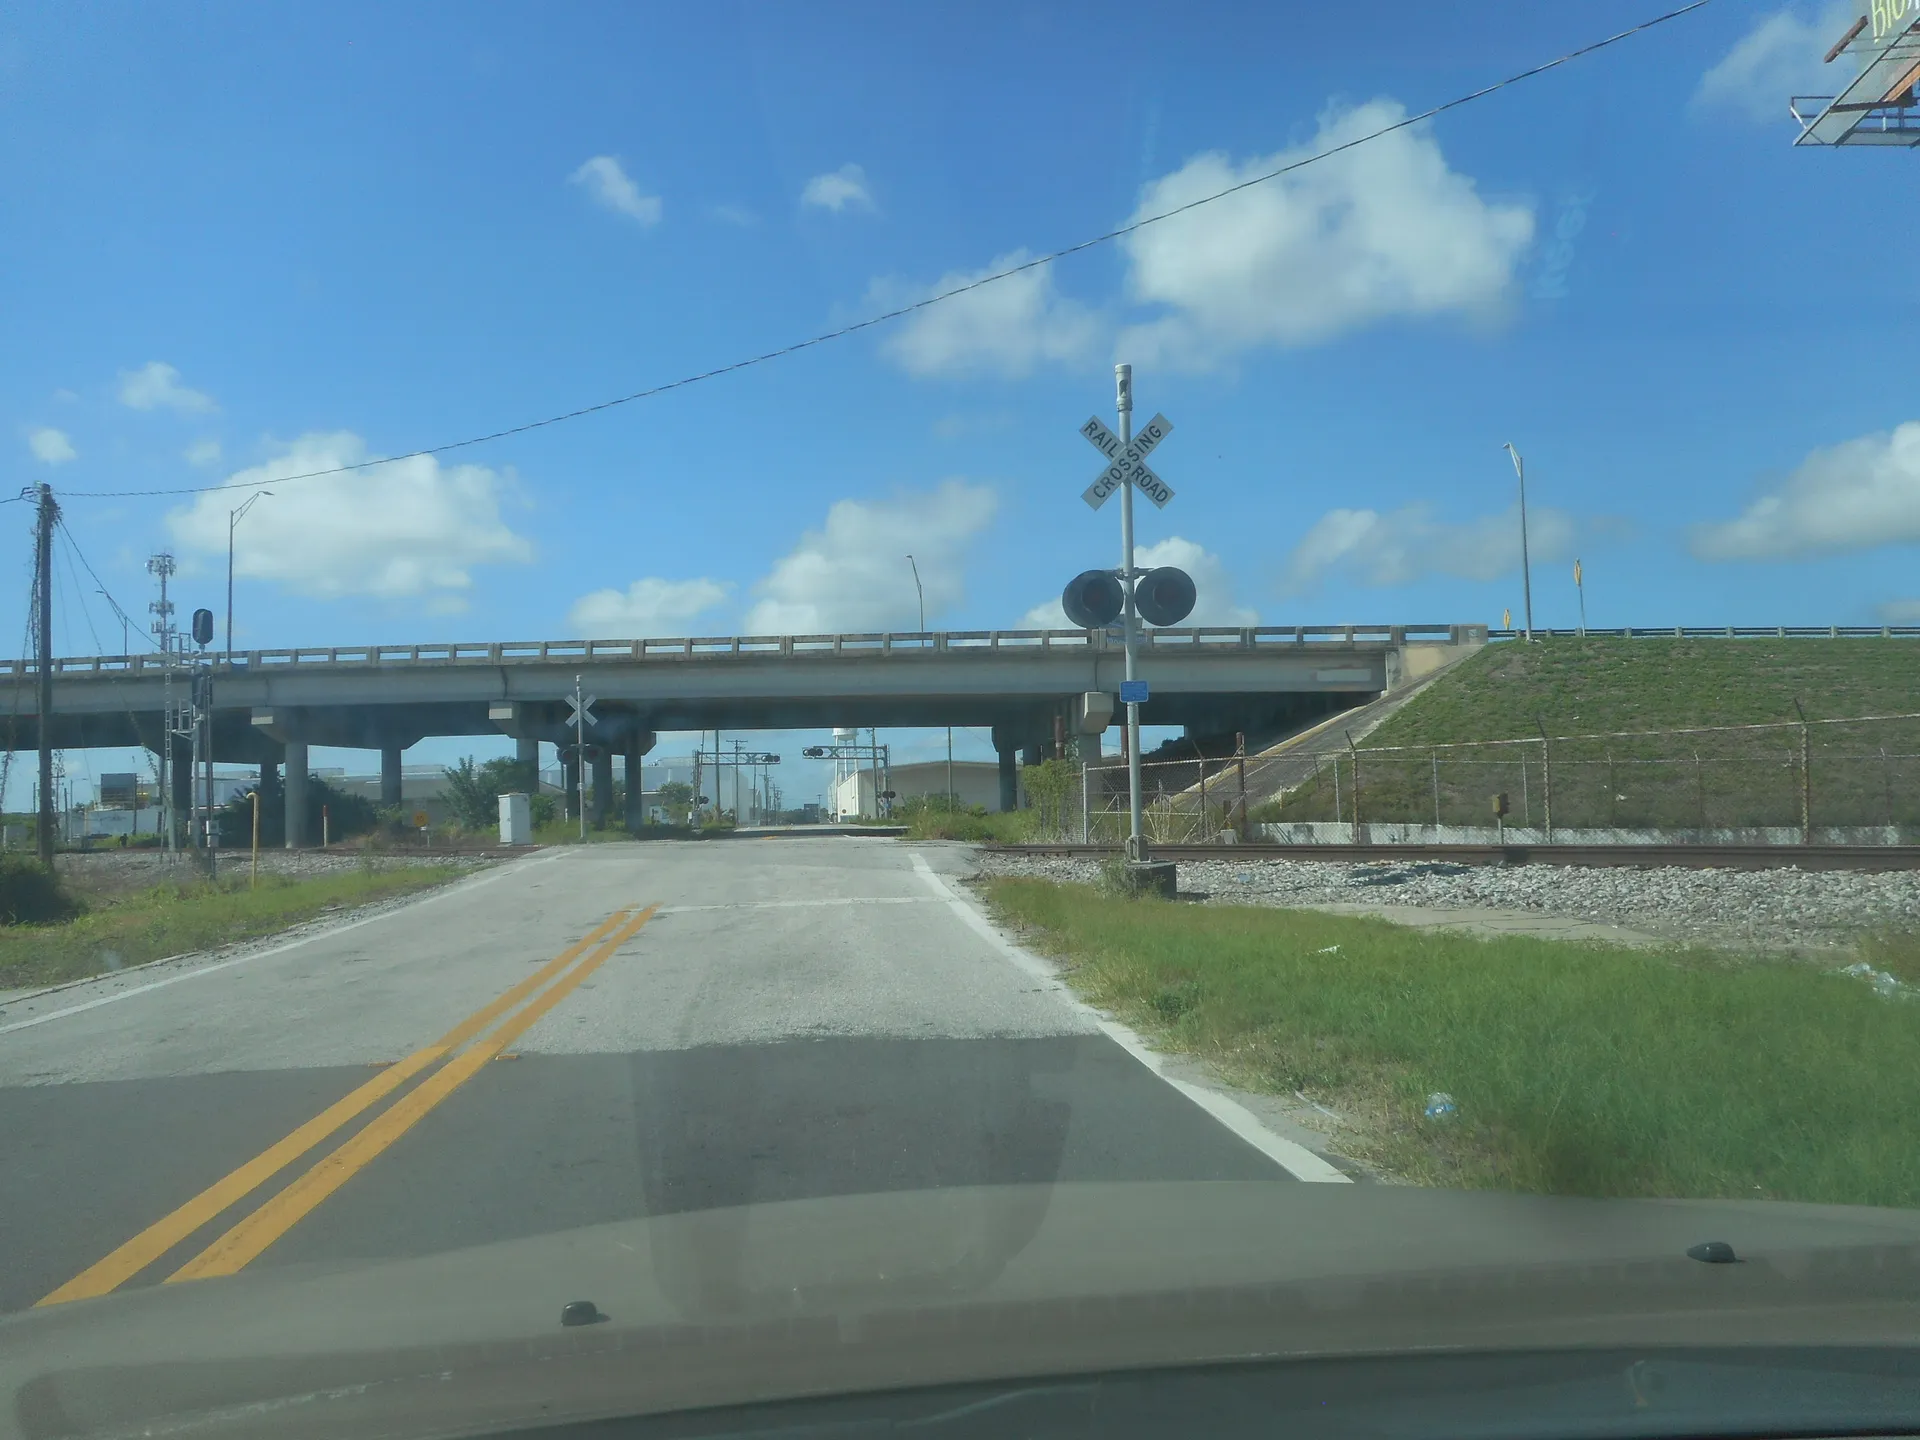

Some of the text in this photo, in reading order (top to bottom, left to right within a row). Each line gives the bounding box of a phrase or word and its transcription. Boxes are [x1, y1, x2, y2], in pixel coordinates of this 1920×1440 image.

[1084, 420, 1168, 502] RAIL ROAD
[1093, 425, 1162, 498] CROSSING
